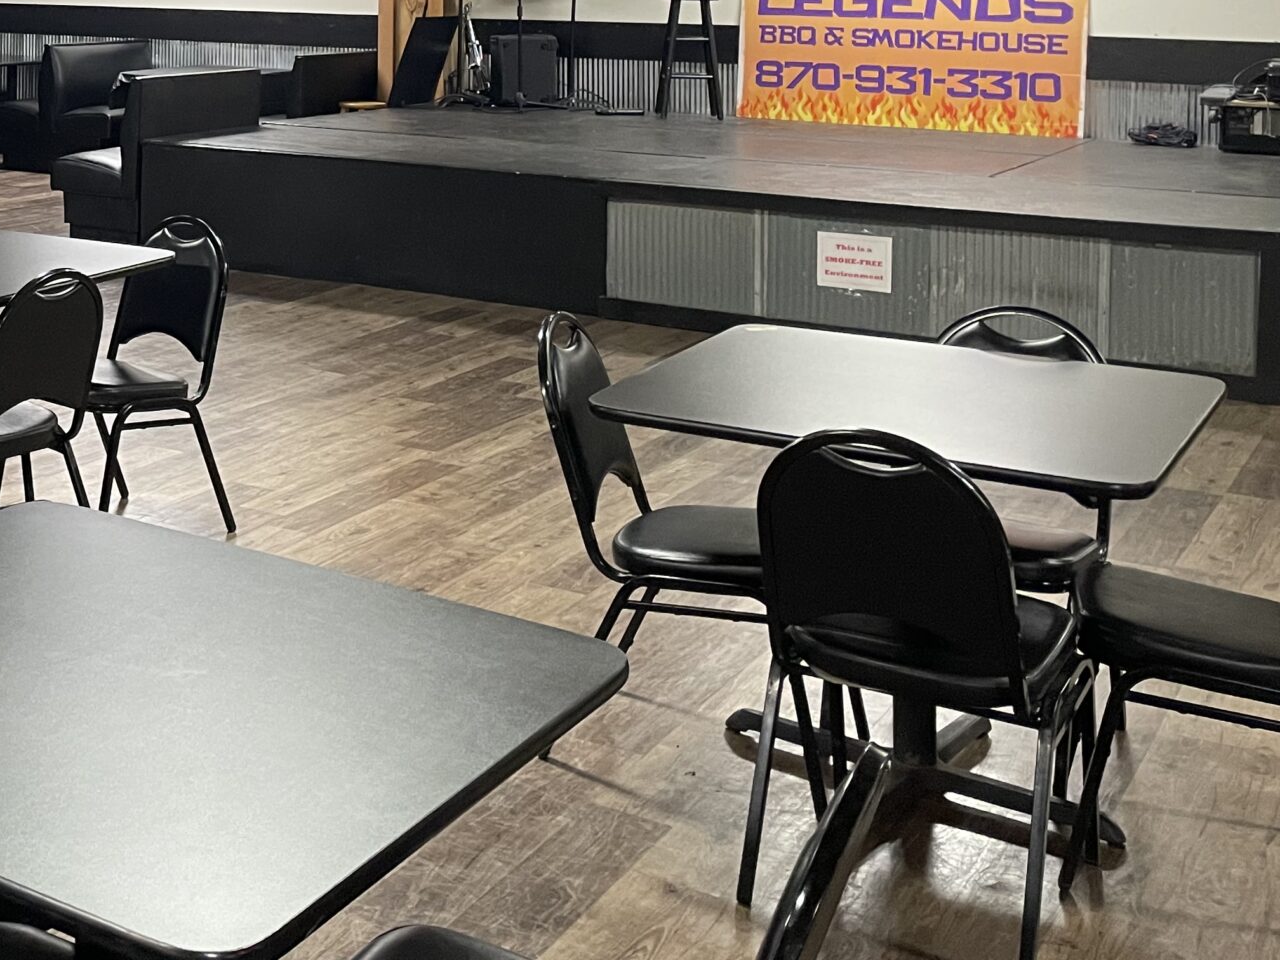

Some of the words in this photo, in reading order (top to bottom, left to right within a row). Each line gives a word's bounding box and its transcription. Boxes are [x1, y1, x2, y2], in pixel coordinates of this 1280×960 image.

[758, 24, 817, 46] BBQ
[824, 27, 845, 47] &
[851, 27, 1070, 56] SMOKEHOUSE
[754, 59, 1063, 103] 870-931-3310
[836, 243, 856, 252] This
[825, 256, 884, 268] SMOKE-FREE
[824, 269, 884, 280] Environment
